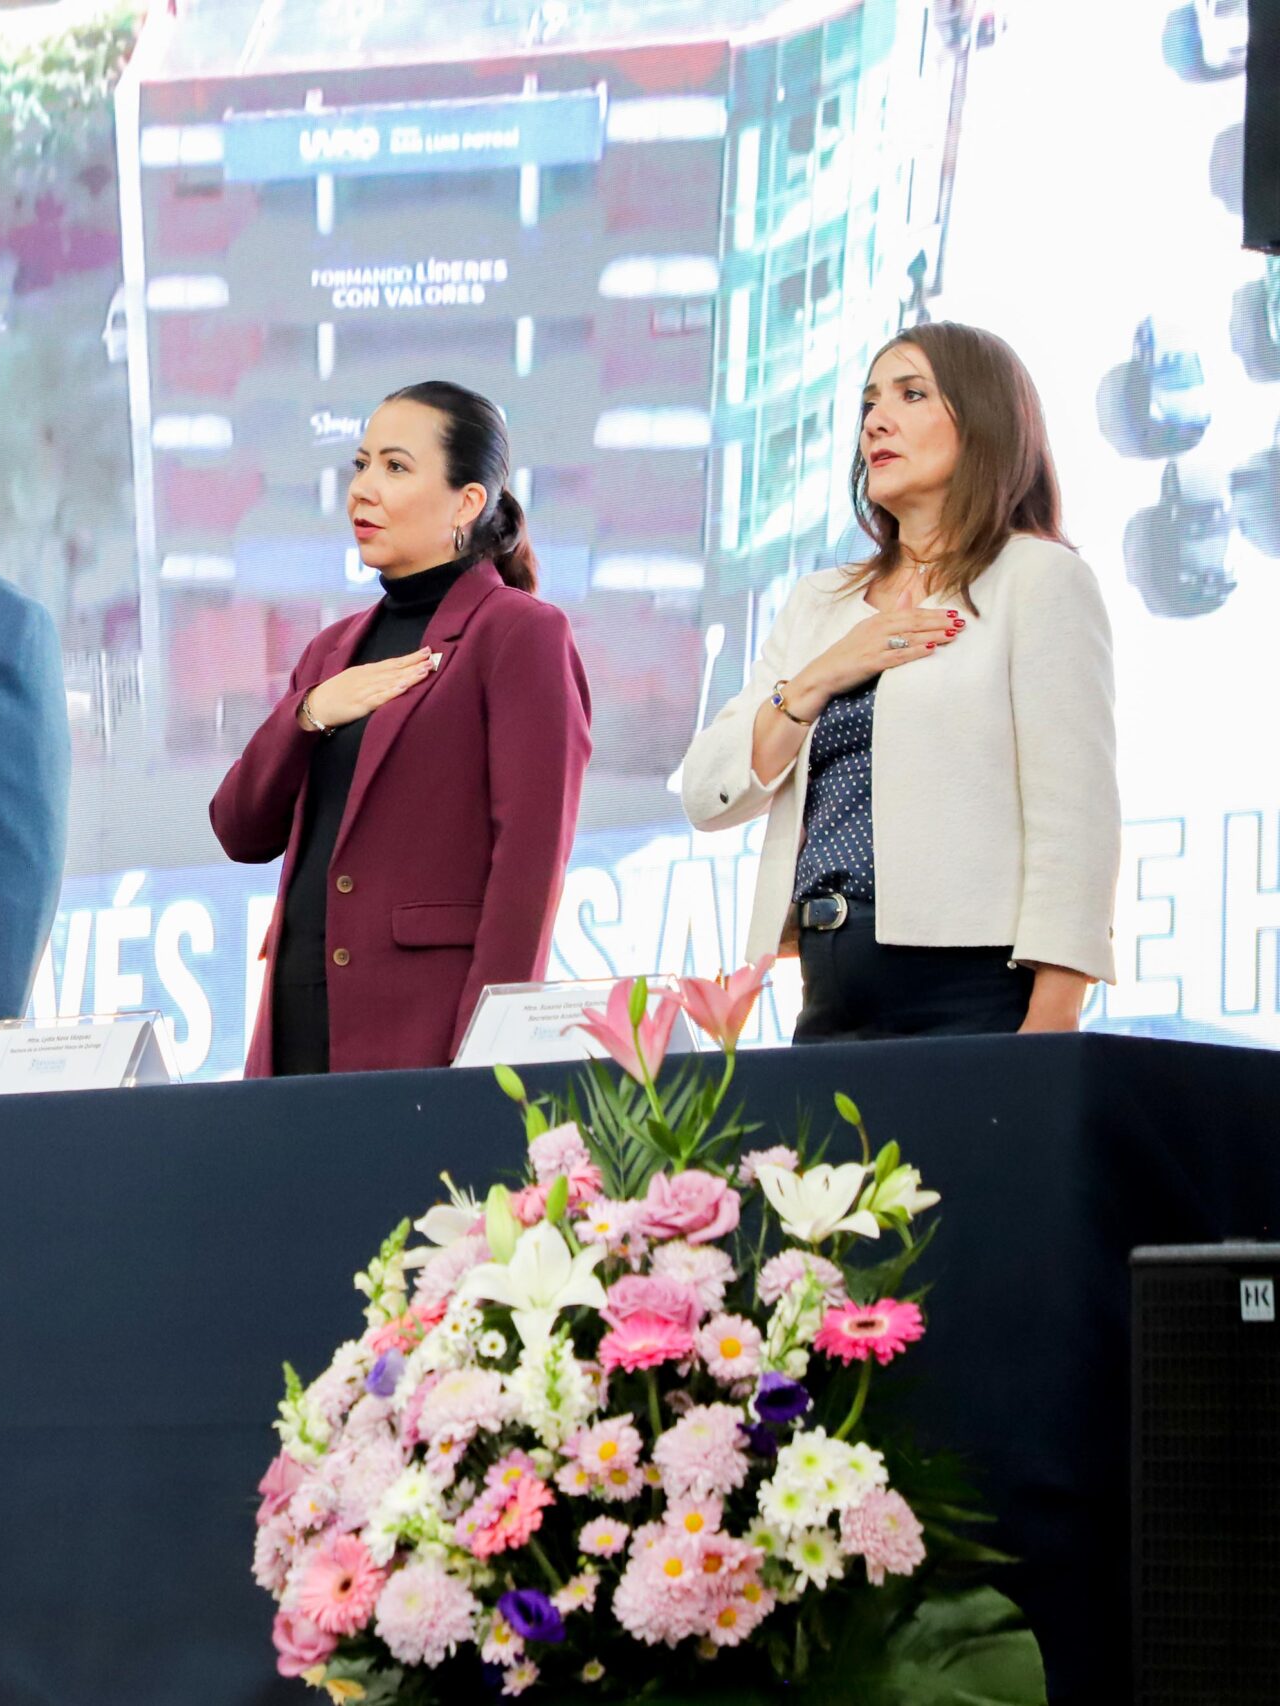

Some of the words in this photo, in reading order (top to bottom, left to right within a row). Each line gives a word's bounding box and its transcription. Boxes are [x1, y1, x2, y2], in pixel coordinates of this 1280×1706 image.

[311, 264, 413, 287] FORMANDO
[415, 257, 508, 285] LÍDERES
[332, 287, 380, 309] CON
[383, 284, 486, 308] VALORES
[28, 870, 216, 1080] VÉS
